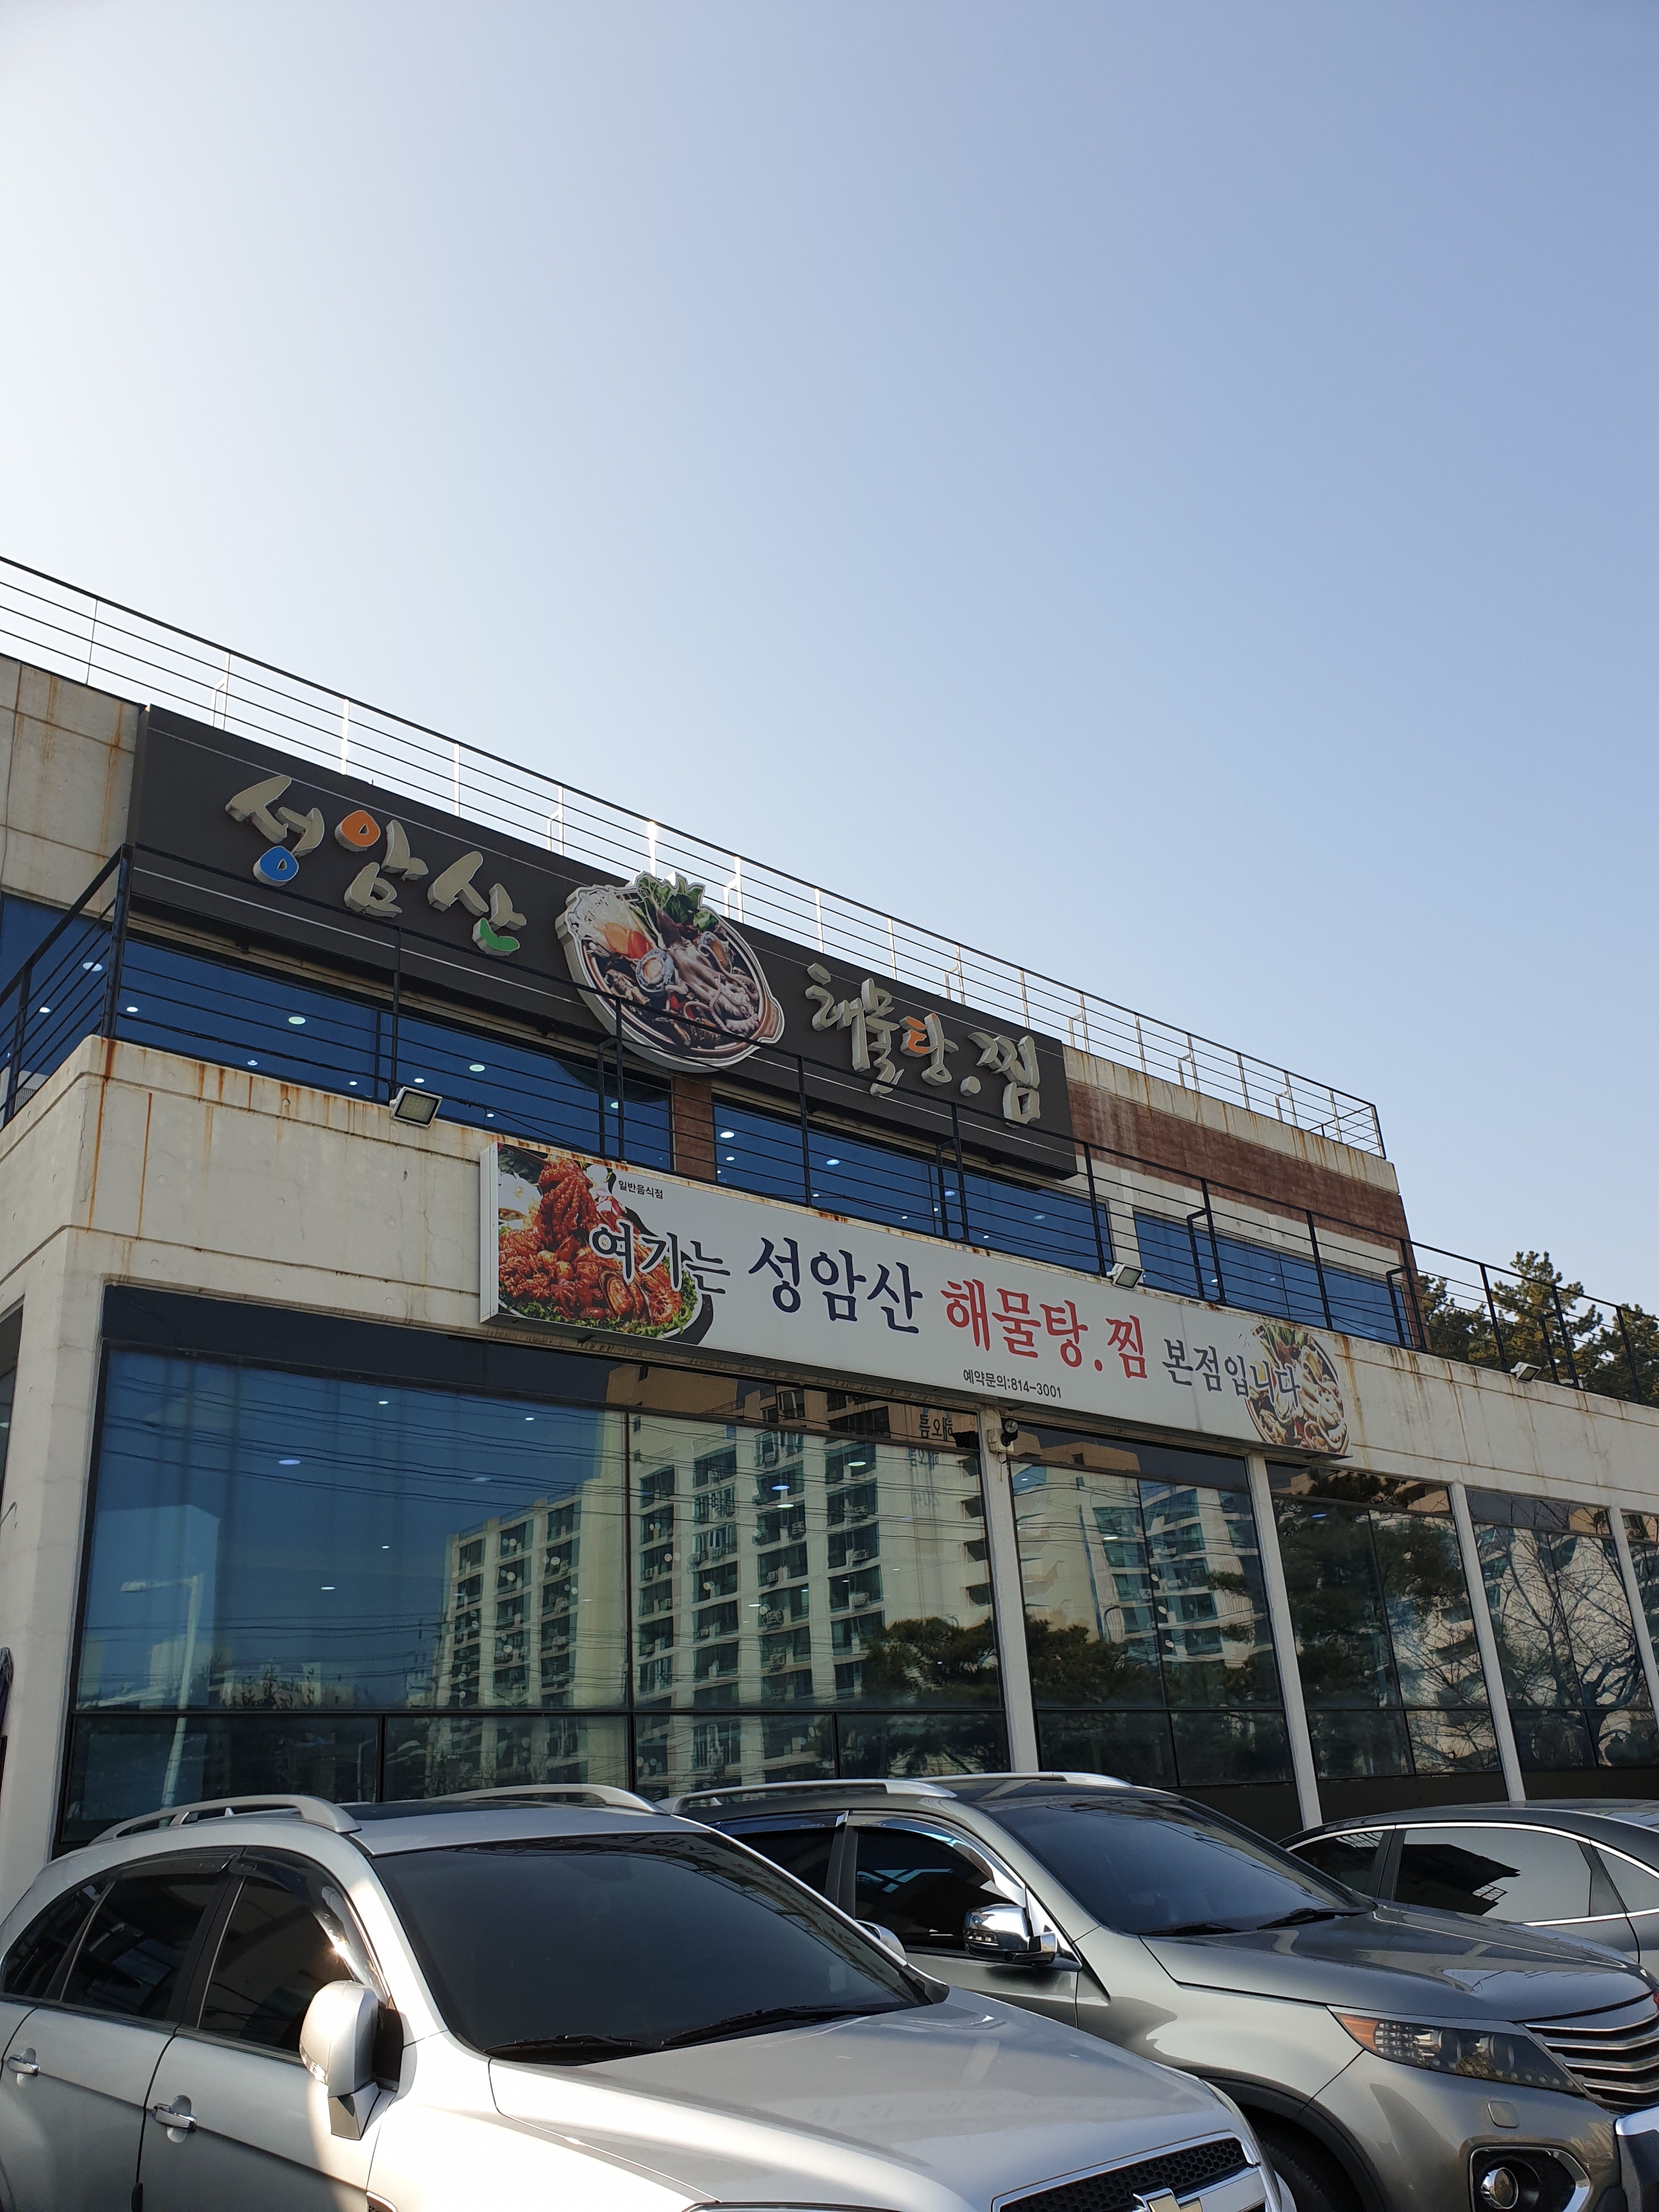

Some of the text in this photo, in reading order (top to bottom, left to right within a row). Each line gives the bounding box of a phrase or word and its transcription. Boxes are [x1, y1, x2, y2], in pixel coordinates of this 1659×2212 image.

[225, 775, 527, 956] 성암산
[618, 1180, 663, 1199] 일반음식점
[591, 1221, 1301, 1409] 여기는 성암산 해물탕.찜 본점입니다
